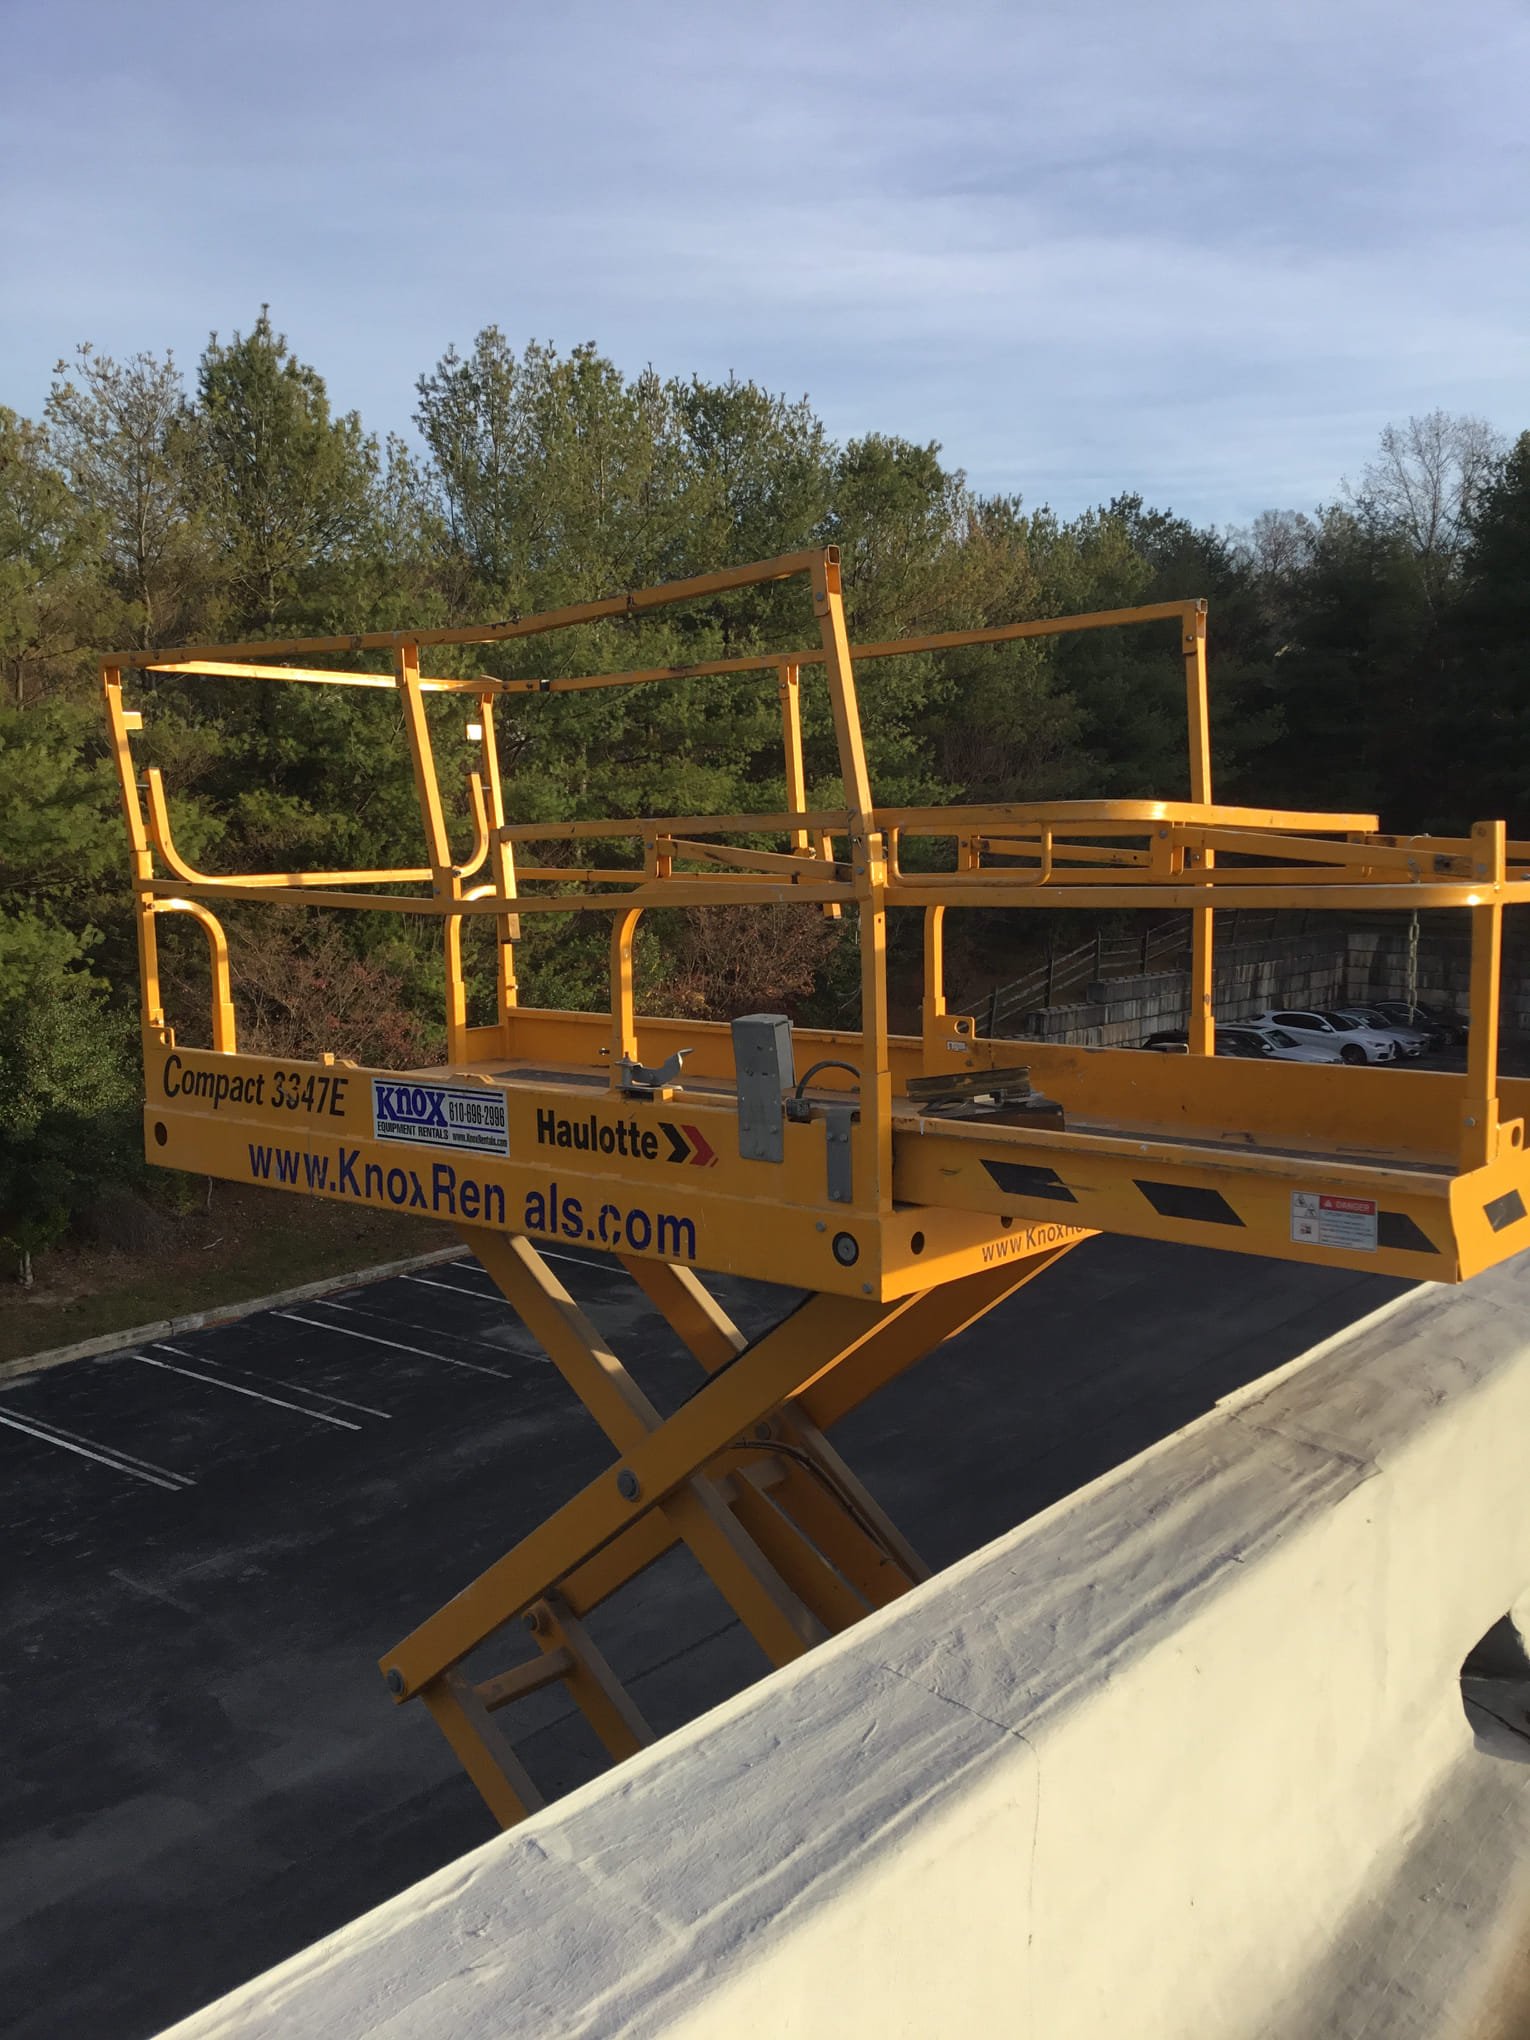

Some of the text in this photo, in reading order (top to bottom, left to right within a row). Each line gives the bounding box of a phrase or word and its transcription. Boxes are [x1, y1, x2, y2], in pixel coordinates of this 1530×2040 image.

[163, 1055, 349, 1116] Compact 3347E
[377, 1121, 449, 1140] EQUIPMENT RENTALS
[449, 1101, 505, 1127] 610-696-2996
[536, 1108, 659, 1160] Haulotte
